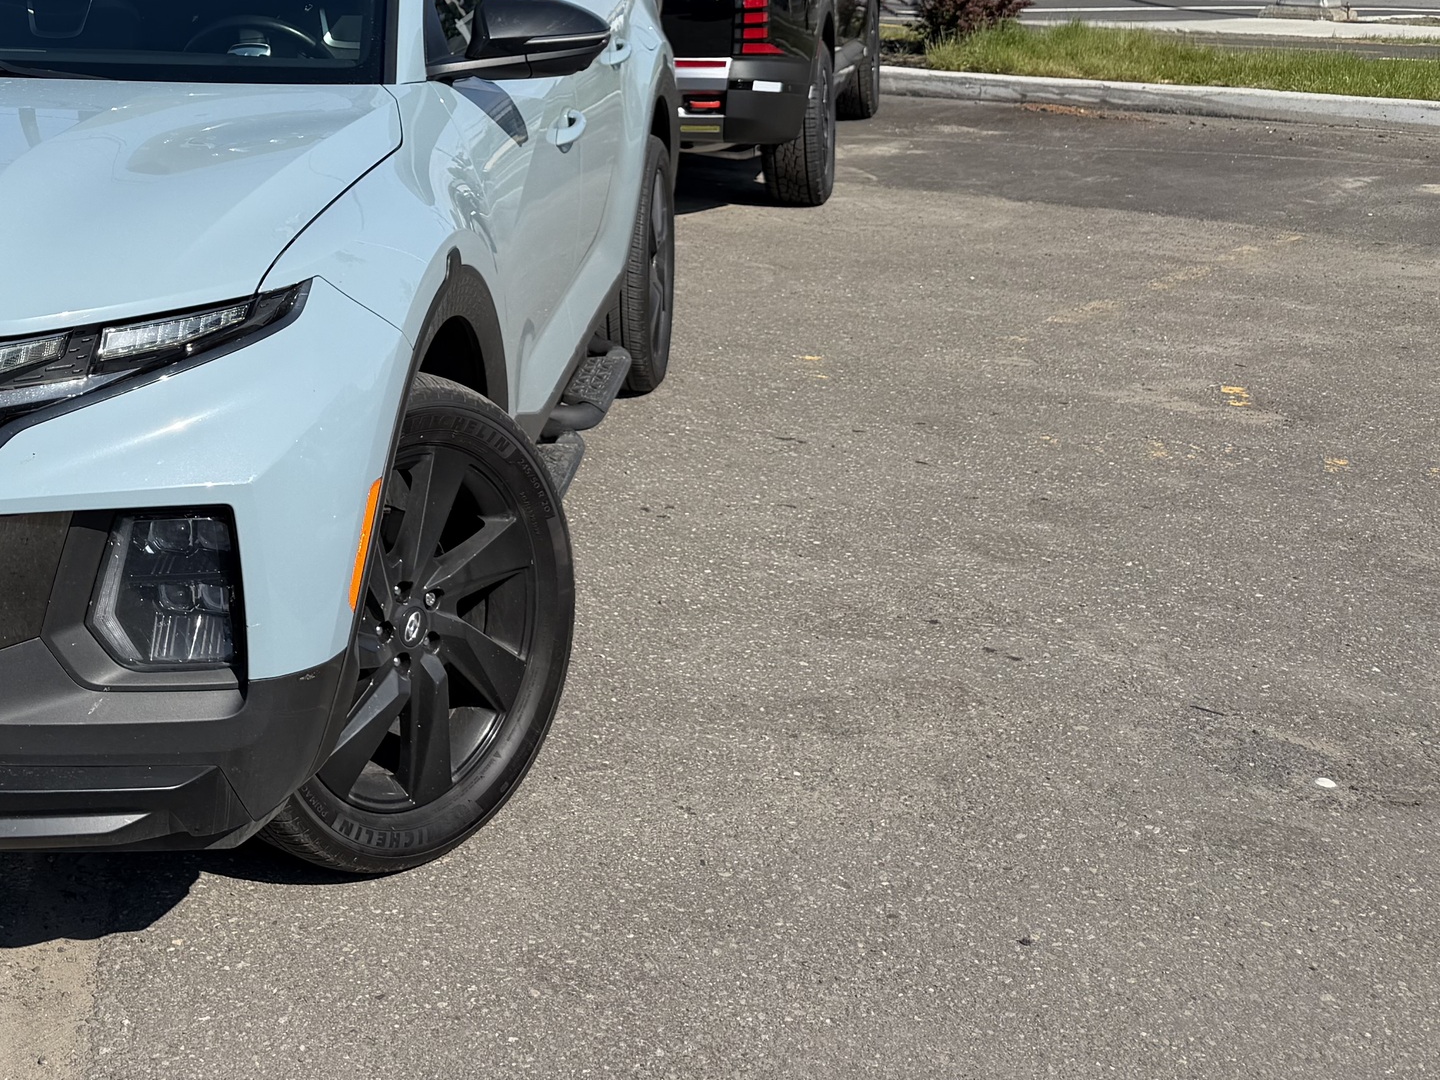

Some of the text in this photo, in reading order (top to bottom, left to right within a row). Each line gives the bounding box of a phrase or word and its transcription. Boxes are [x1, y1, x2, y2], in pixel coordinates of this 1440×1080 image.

[410, 414, 510, 454] MICHELIN
[517, 458, 541, 489] 245/50
[537, 491, 545, 499] R
[541, 500, 551, 513] 20
[339, 818, 442, 849] MICHELIN
